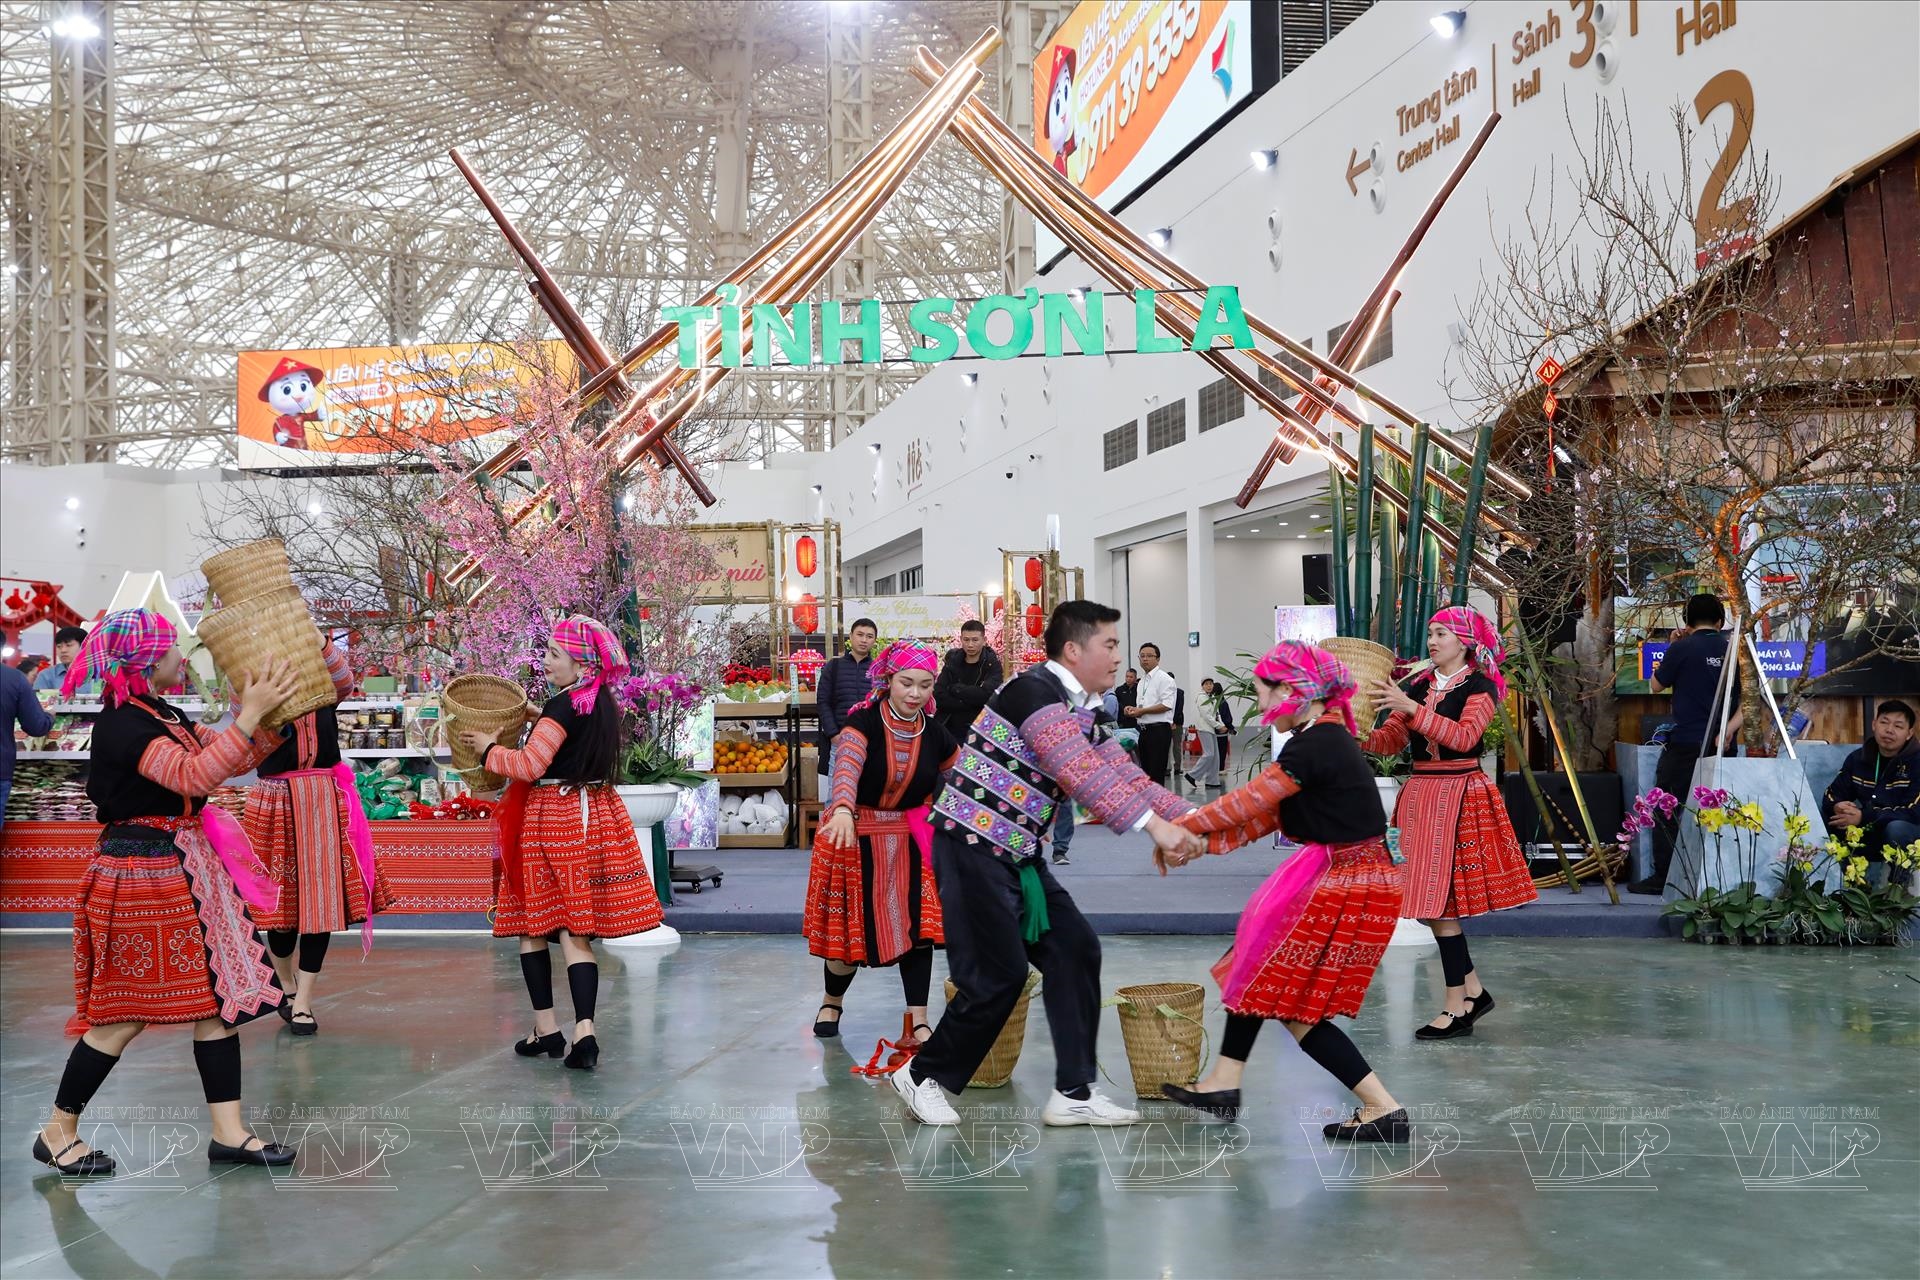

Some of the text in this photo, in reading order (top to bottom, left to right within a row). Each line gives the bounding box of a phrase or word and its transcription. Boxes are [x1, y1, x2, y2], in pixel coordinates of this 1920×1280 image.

[1512, 8, 1561, 65] Sảnh
[1075, 80, 1116, 185] 0911
[1119, 45, 1144, 128] 39
[1396, 66, 1477, 136] Trung tâm
[1513, 67, 1541, 107] Hall
[1396, 113, 1460, 173] Center Hall
[661, 283, 1255, 368] TỈNH SƠN LA
[326, 363, 360, 385] LIÊN
[364, 358, 385, 383] HỆ
[727, 559, 767, 582] núi
